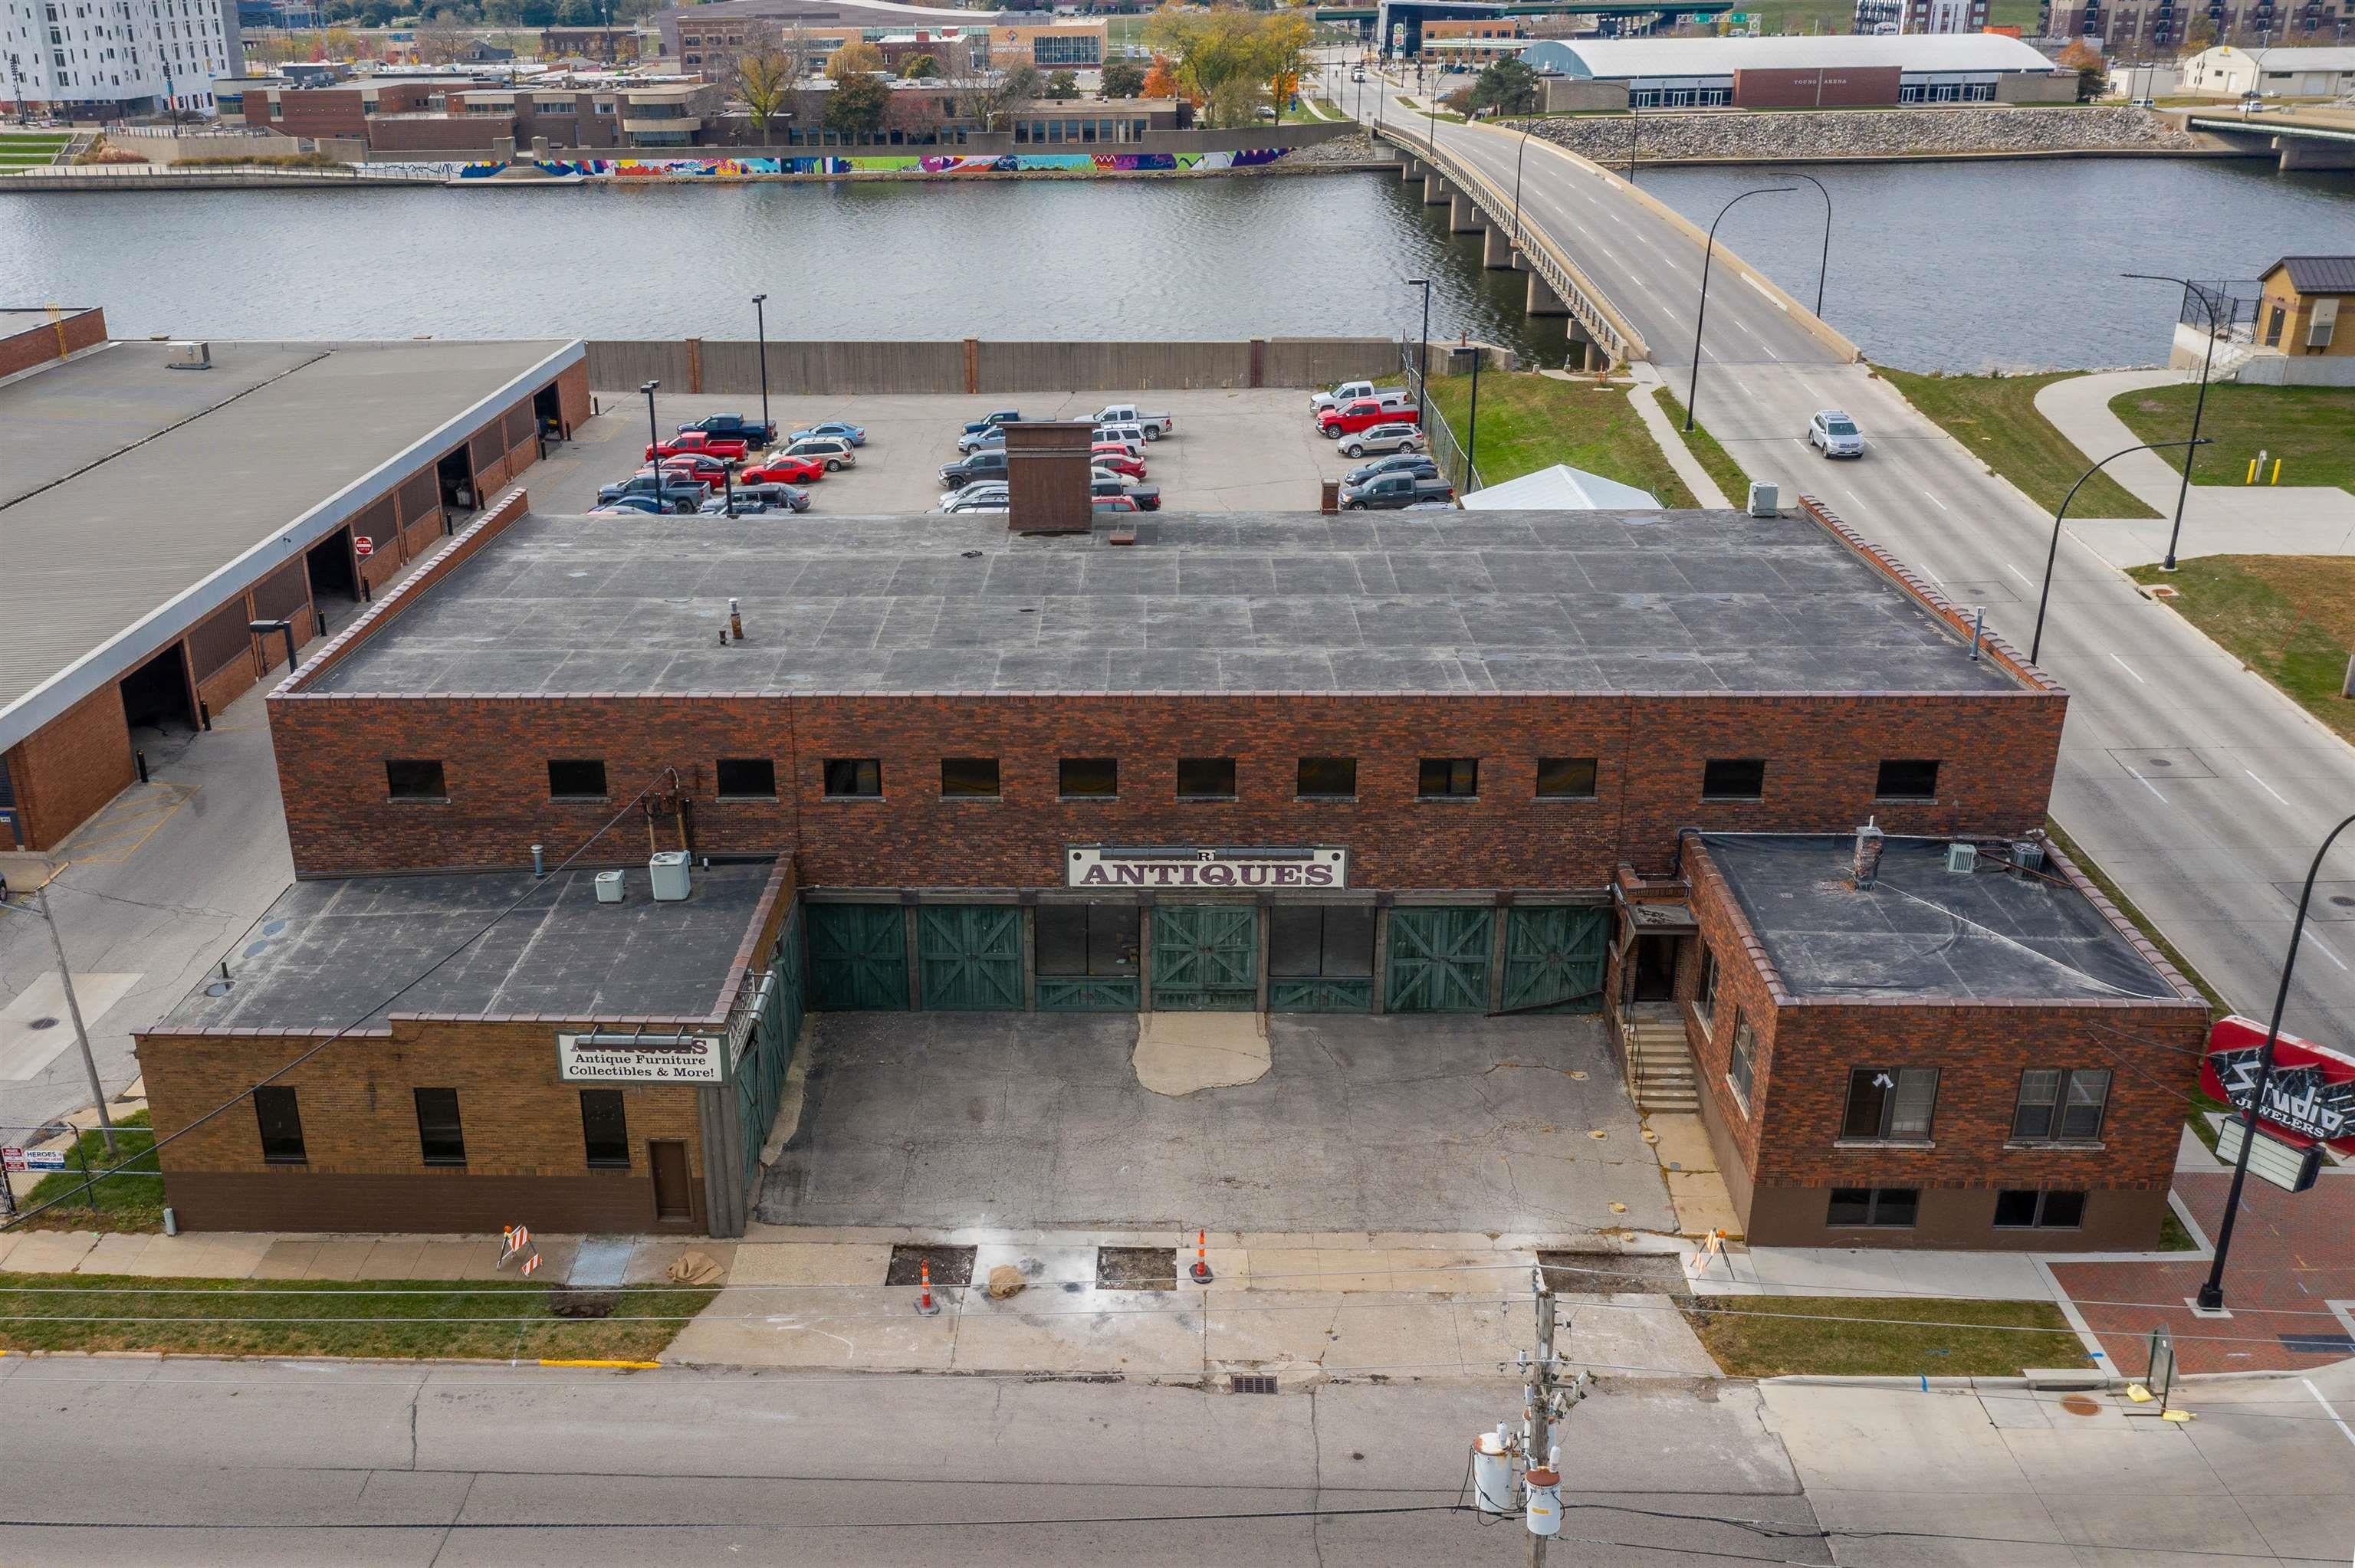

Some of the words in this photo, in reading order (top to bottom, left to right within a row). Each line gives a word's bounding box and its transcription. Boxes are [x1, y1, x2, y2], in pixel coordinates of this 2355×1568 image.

[1079, 864, 1334, 886] ANTIQUES
[575, 1054, 632, 1065] Antique
[635, 1055, 706, 1065] Furniture
[569, 1065, 652, 1076] Collectibles
[656, 1068, 668, 1077] &
[672, 1068, 714, 1078] More!
